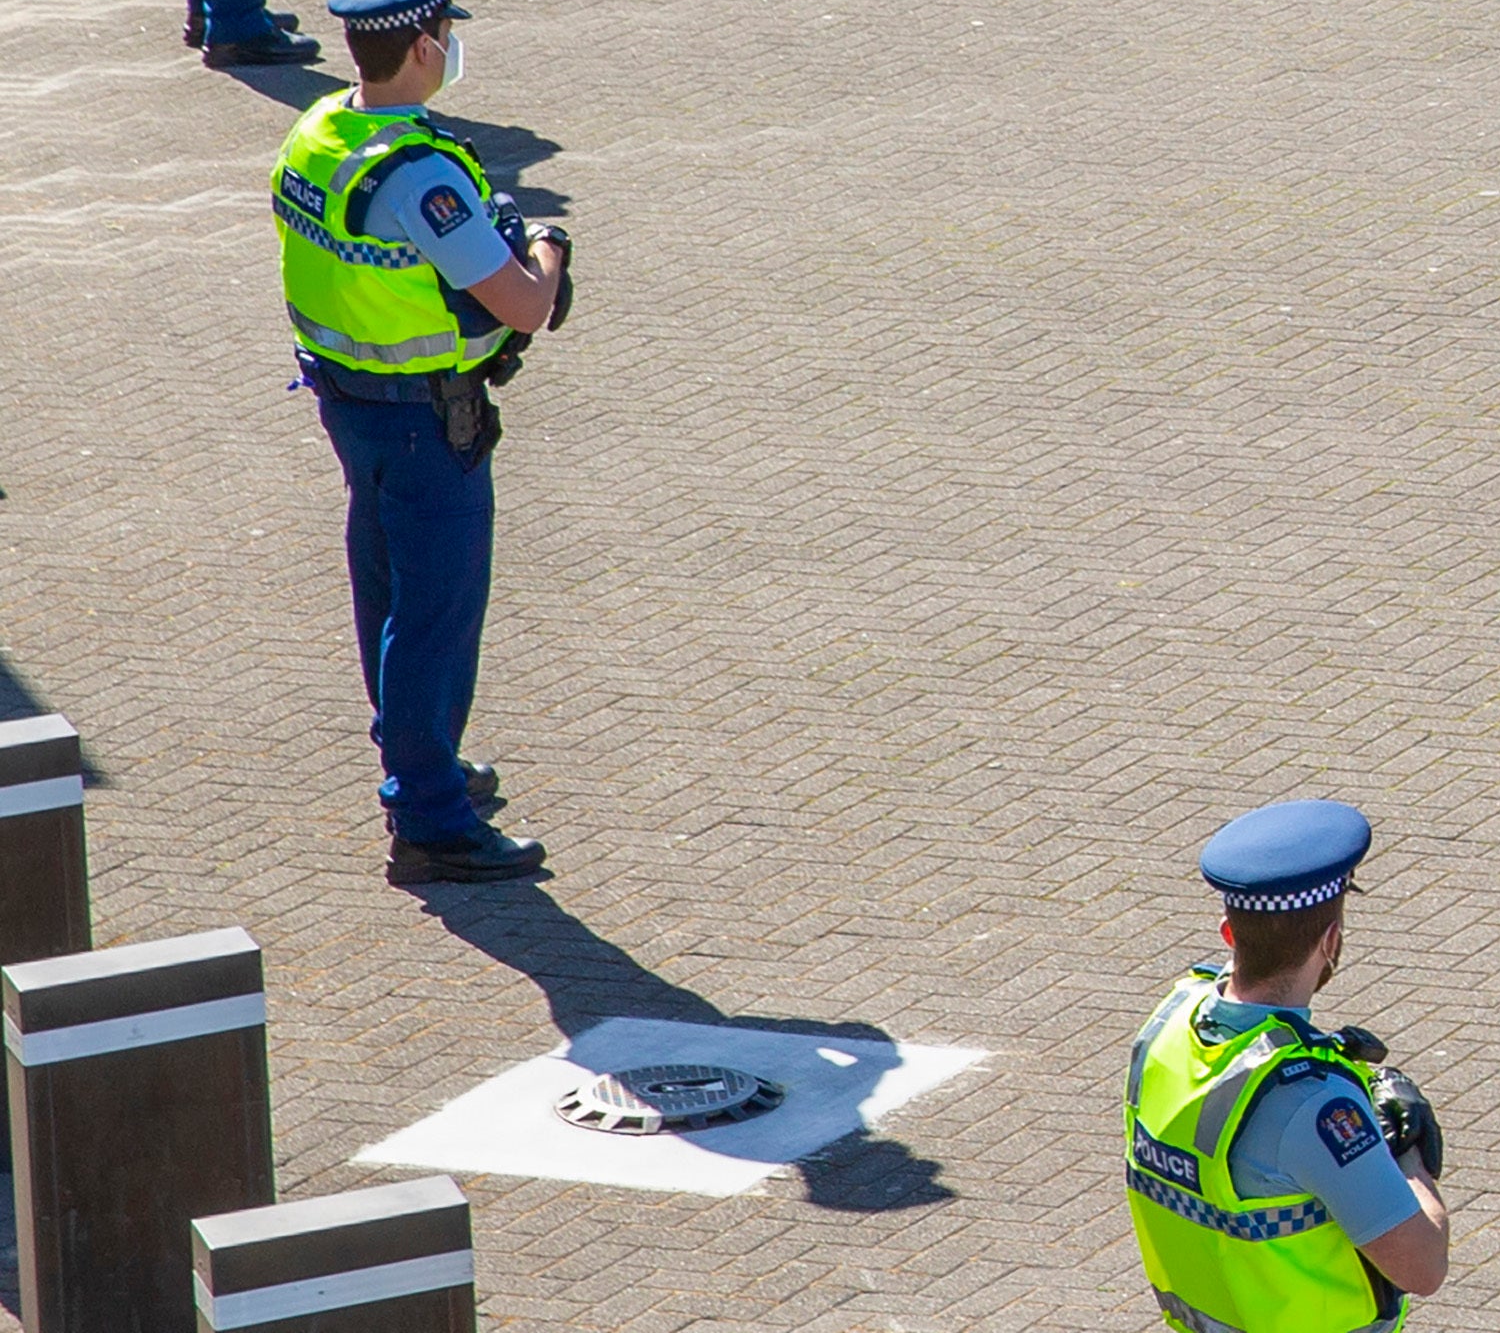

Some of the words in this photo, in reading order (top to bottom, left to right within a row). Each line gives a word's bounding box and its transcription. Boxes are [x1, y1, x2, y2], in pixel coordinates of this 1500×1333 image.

[283, 175, 324, 214] POLICE
[1134, 1130, 1197, 1184] POLICE
[1341, 1134, 1376, 1162] POLICE
